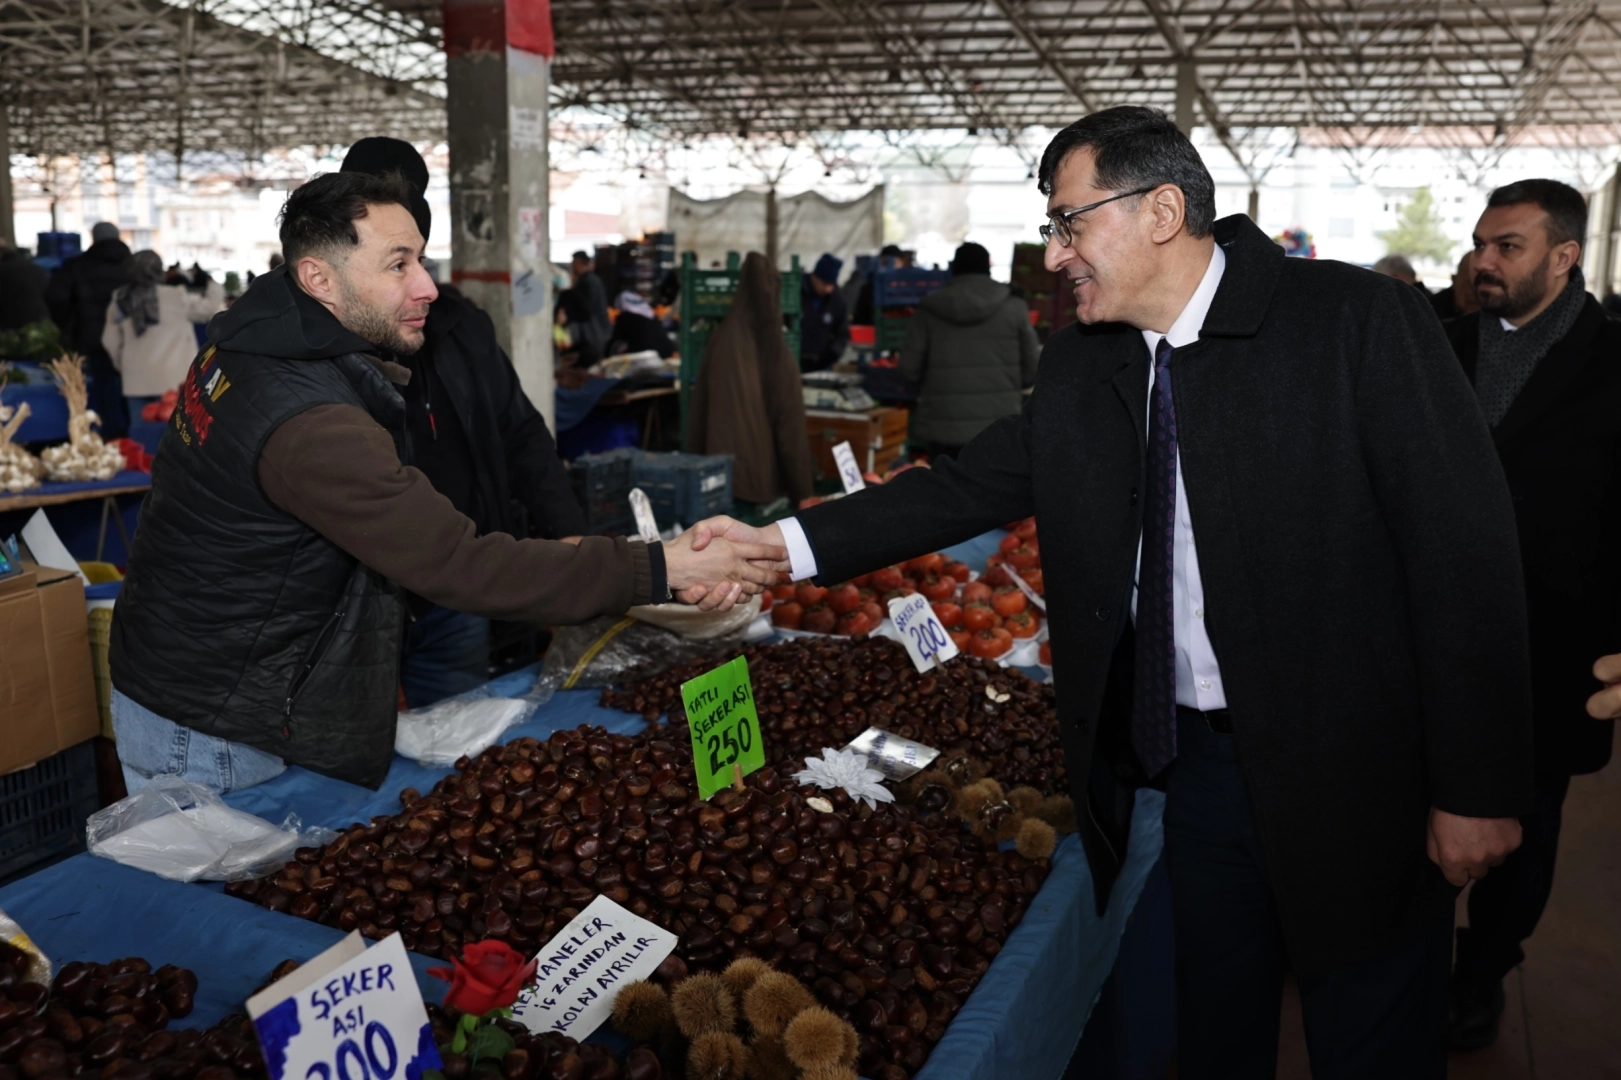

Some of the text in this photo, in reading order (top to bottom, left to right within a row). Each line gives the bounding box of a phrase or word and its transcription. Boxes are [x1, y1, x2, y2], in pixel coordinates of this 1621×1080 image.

[910, 617, 947, 661] 200
[688, 687, 719, 714] TATLI
[707, 717, 751, 776] 250
[311, 963, 395, 1020] ŞEKER
[551, 931, 627, 995] ZARINDAN
[551, 936, 658, 1032] KOLAY AYRILIR
[332, 1005, 364, 1039] AŞI
